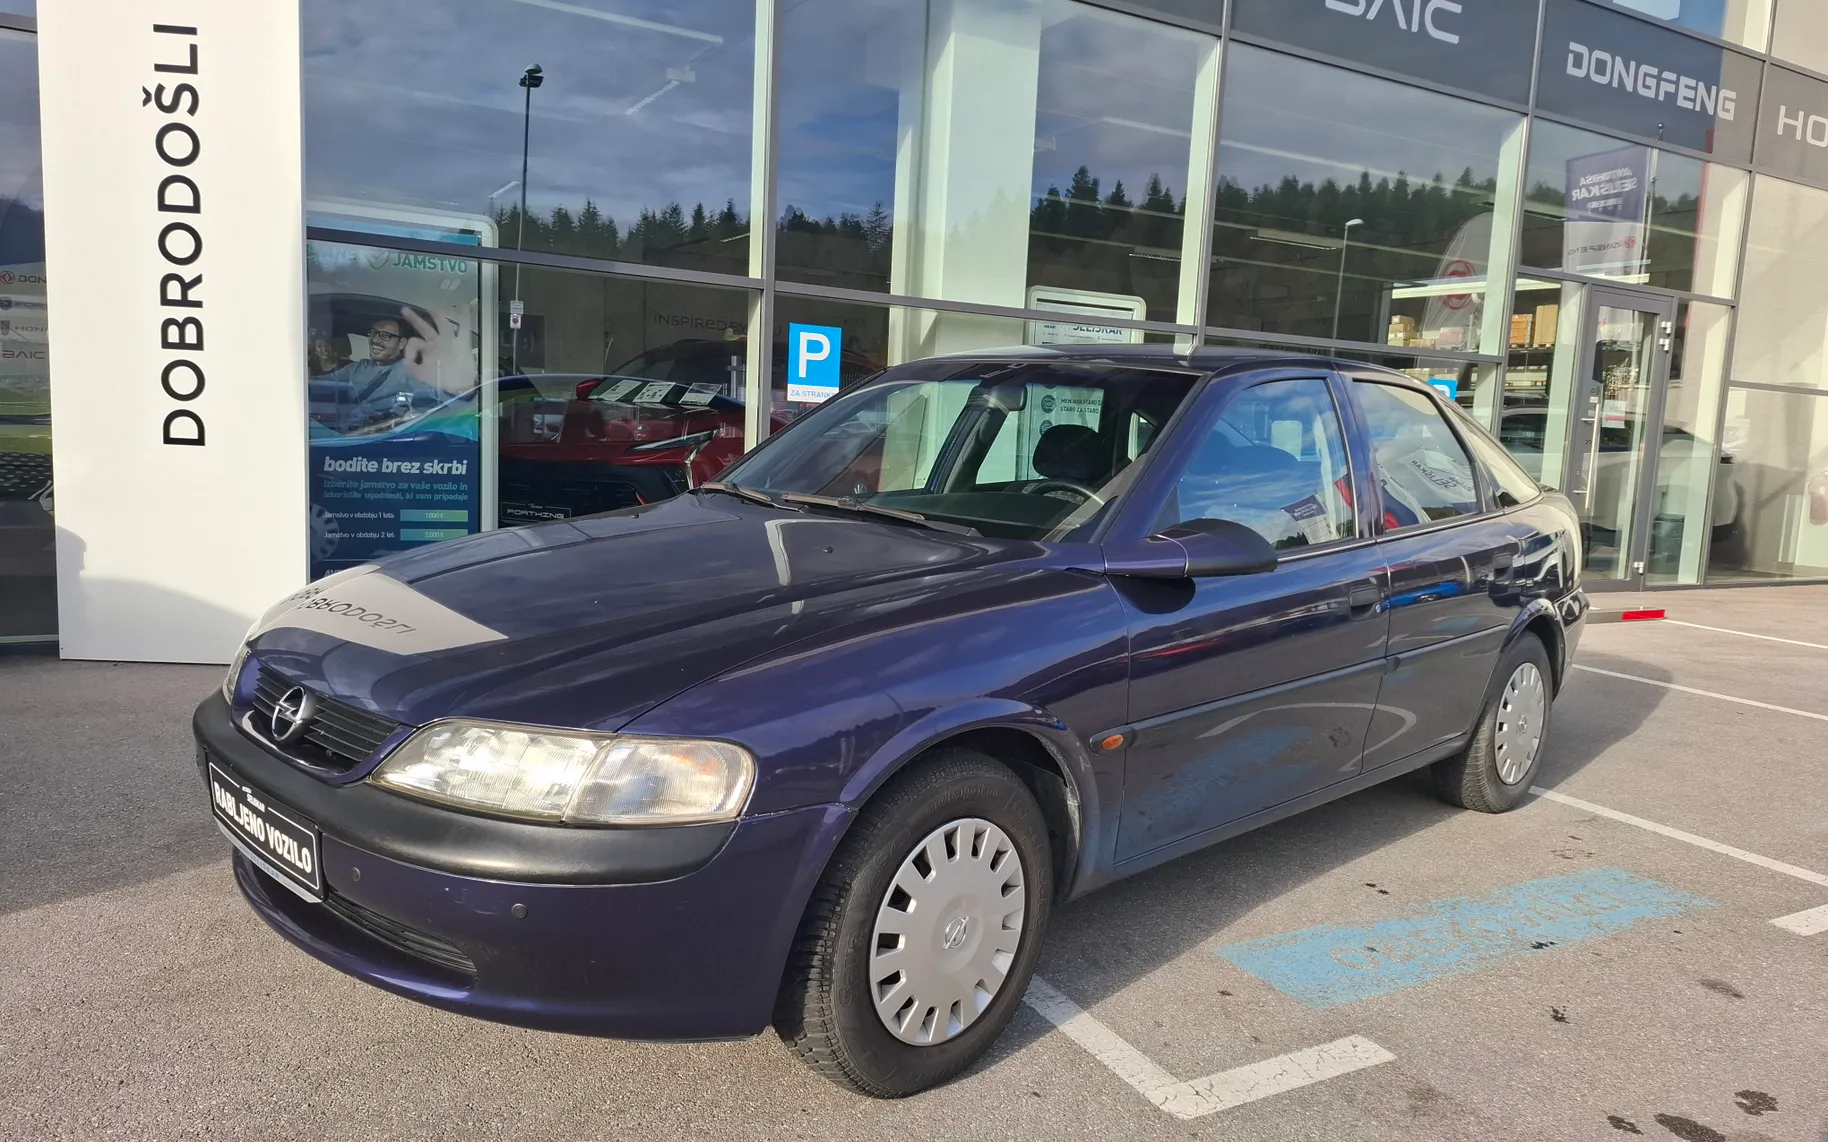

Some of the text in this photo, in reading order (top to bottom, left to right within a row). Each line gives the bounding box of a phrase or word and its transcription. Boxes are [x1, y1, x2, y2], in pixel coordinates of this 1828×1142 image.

[1567, 42, 1737, 121] DONGFENG
[1777, 105, 1828, 147] HO
[142, 23, 206, 447] DOBRODOŠLI
[393, 252, 468, 273] JAMSTVO
[799, 332, 831, 378] P
[324, 456, 468, 475] bodite brez skrbi
[360, 480, 396, 490] jamstvo
[411, 481, 431, 490] vaše
[433, 482, 458, 490] vozilo
[460, 482, 468, 490] in
[507, 508, 565, 519] FORTHING
[213, 781, 312, 874] RABLJENO VOZILO
